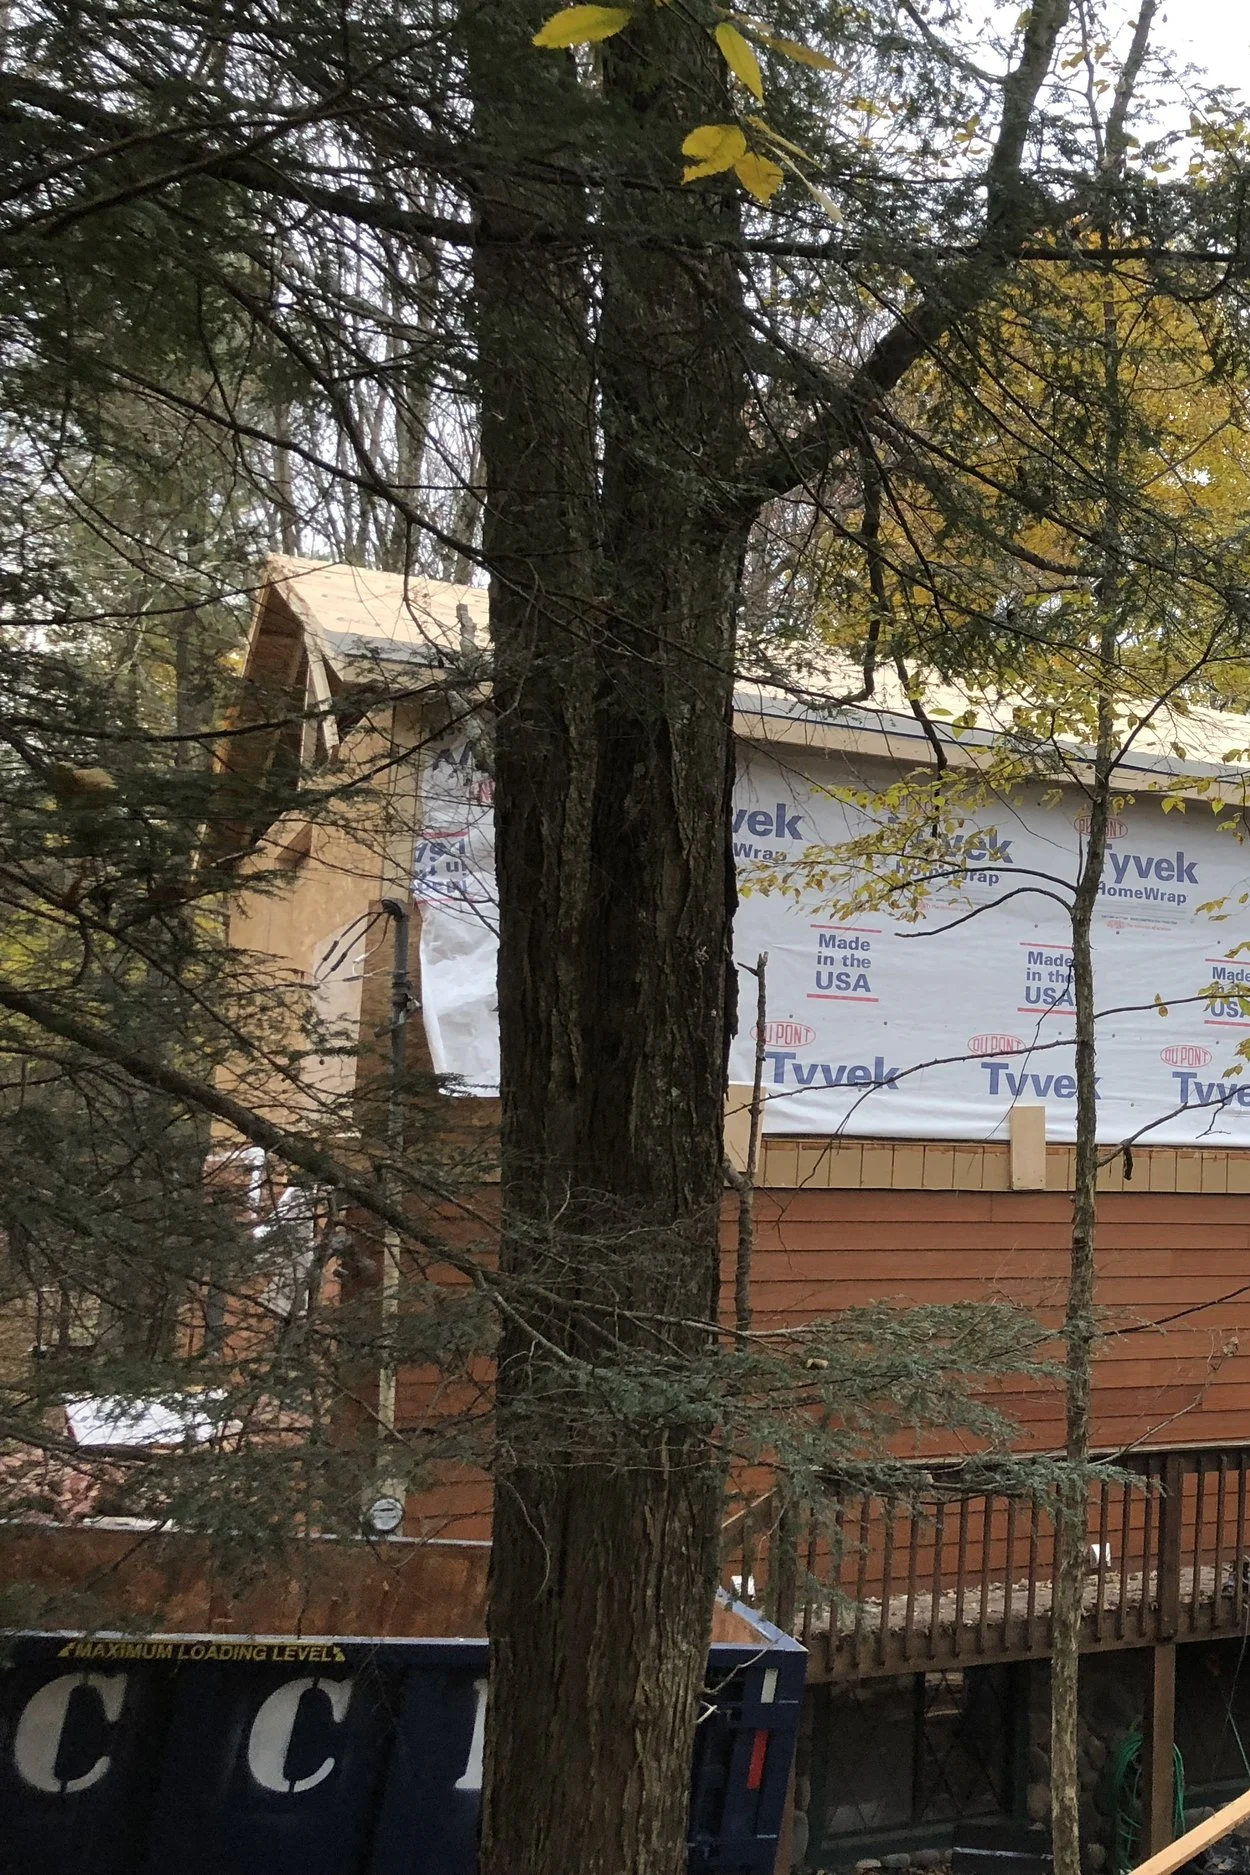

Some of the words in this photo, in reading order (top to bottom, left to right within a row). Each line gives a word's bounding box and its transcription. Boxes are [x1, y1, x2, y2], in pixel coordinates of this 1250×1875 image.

[730, 803, 804, 841] vek
[1104, 843, 1199, 885] yvek
[1096, 881, 1188, 906] HomeWrap
[818, 933, 872, 951] Made
[816, 951, 835, 966] in
[841, 952, 872, 969] the
[1027, 951, 1074, 968] Made
[815, 970, 872, 993] USA
[1026, 968, 1041, 982] in
[1047, 968, 1074, 984] the
[1025, 986, 1075, 1007] USA
[764, 1050, 901, 1091] Tyvek
[981, 1061, 1103, 1100] Tyve
[73, 1642, 173, 1659] MAXIMUM
[178, 1644, 268, 1661] LOADING
[272, 1645, 333, 1662] LEVEL
